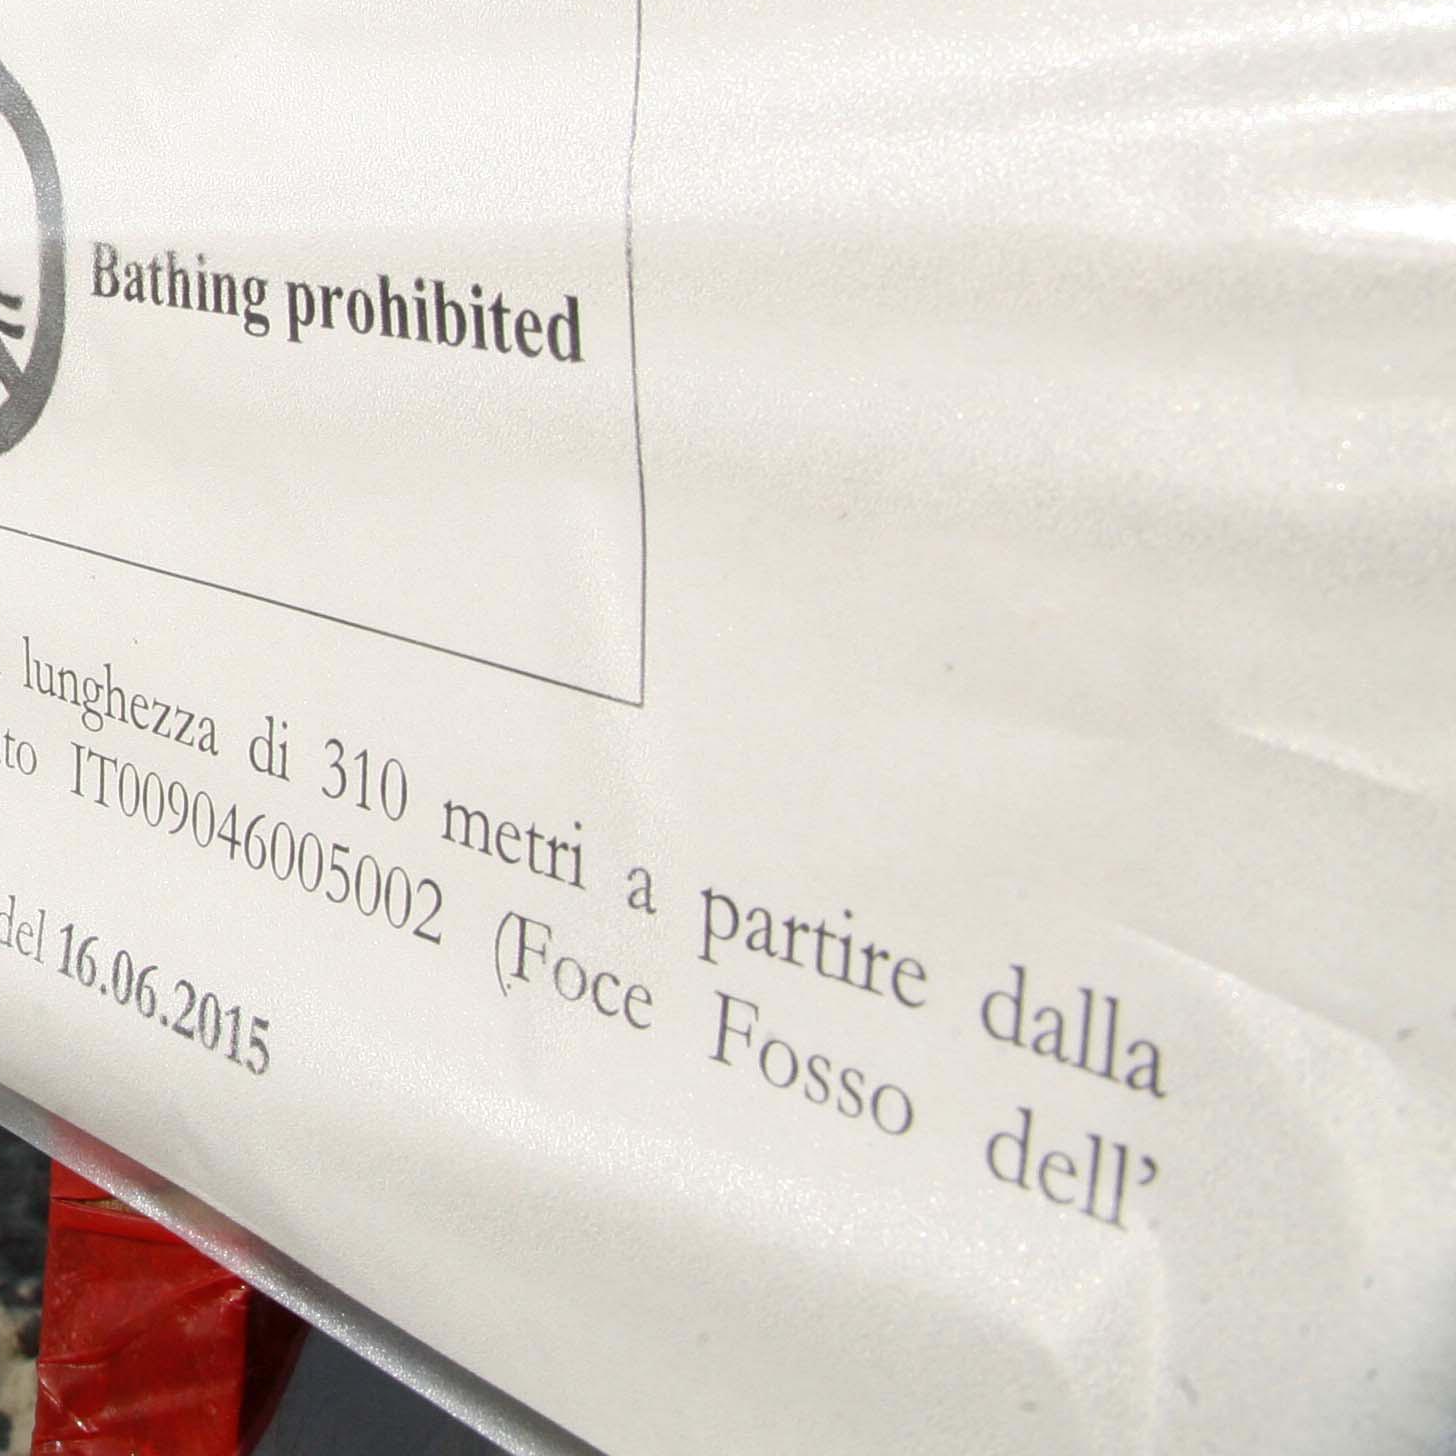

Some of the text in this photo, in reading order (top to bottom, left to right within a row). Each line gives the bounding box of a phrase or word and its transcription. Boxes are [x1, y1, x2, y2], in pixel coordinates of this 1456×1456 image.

[89, 240, 586, 365] Bathing prohibited
[21, 635, 220, 756] lunghezza
[248, 714, 291, 783] di
[320, 737, 409, 821] 310
[440, 793, 587, 890] metri
[625, 864, 659, 916] a
[698, 884, 930, 1010] partire
[979, 963, 1169, 1100] dalla
[55, 923, 272, 1078] 16.06.2015
[68, 740, 444, 946] IT009046005002
[492, 909, 655, 1032] (Foce
[707, 991, 916, 1137] Fosso
